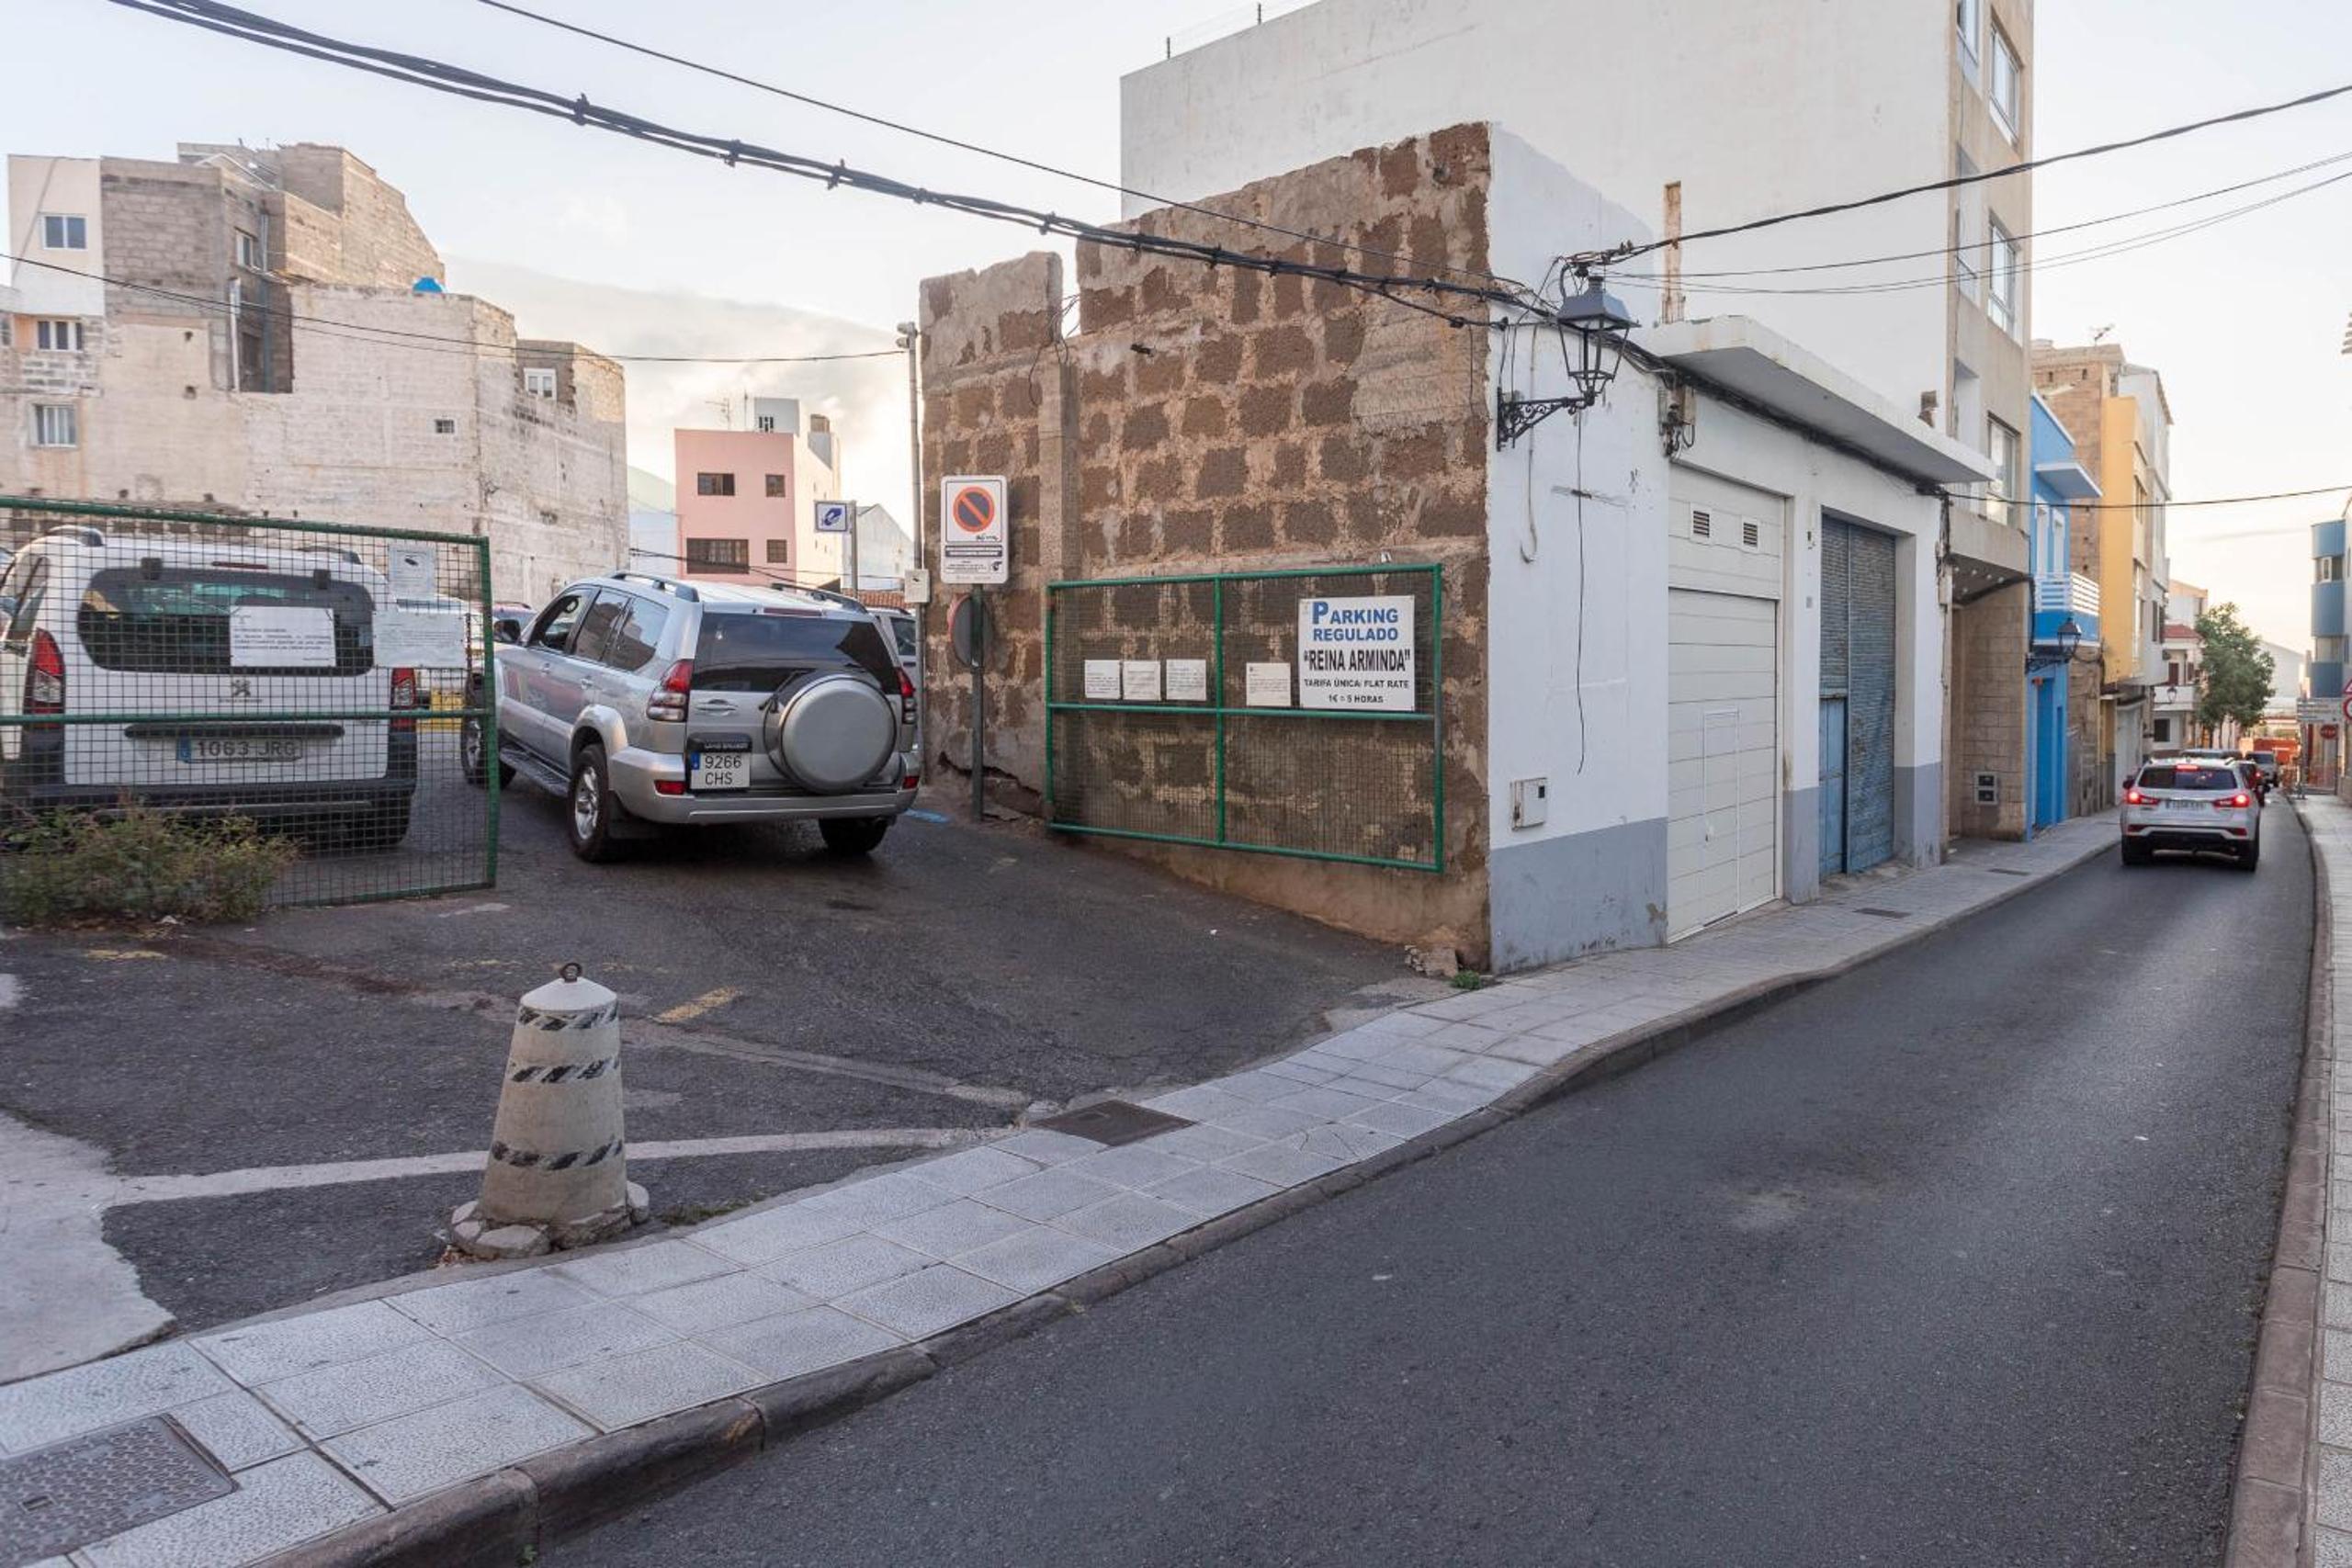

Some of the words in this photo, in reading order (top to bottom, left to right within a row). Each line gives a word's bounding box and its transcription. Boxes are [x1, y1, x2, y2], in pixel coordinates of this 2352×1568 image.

[1312, 601, 1398, 625] PARKING
[1313, 627, 1398, 641] REGULADO
[1304, 679, 1331, 687] TARIFA
[1364, 680, 1385, 688] FLAT
[1387, 680, 1409, 688] RATE
[1354, 695, 1384, 704] HORAS
[198, 740, 249, 757] 1063
[705, 755, 742, 769] 9266
[705, 772, 732, 785] CHS
